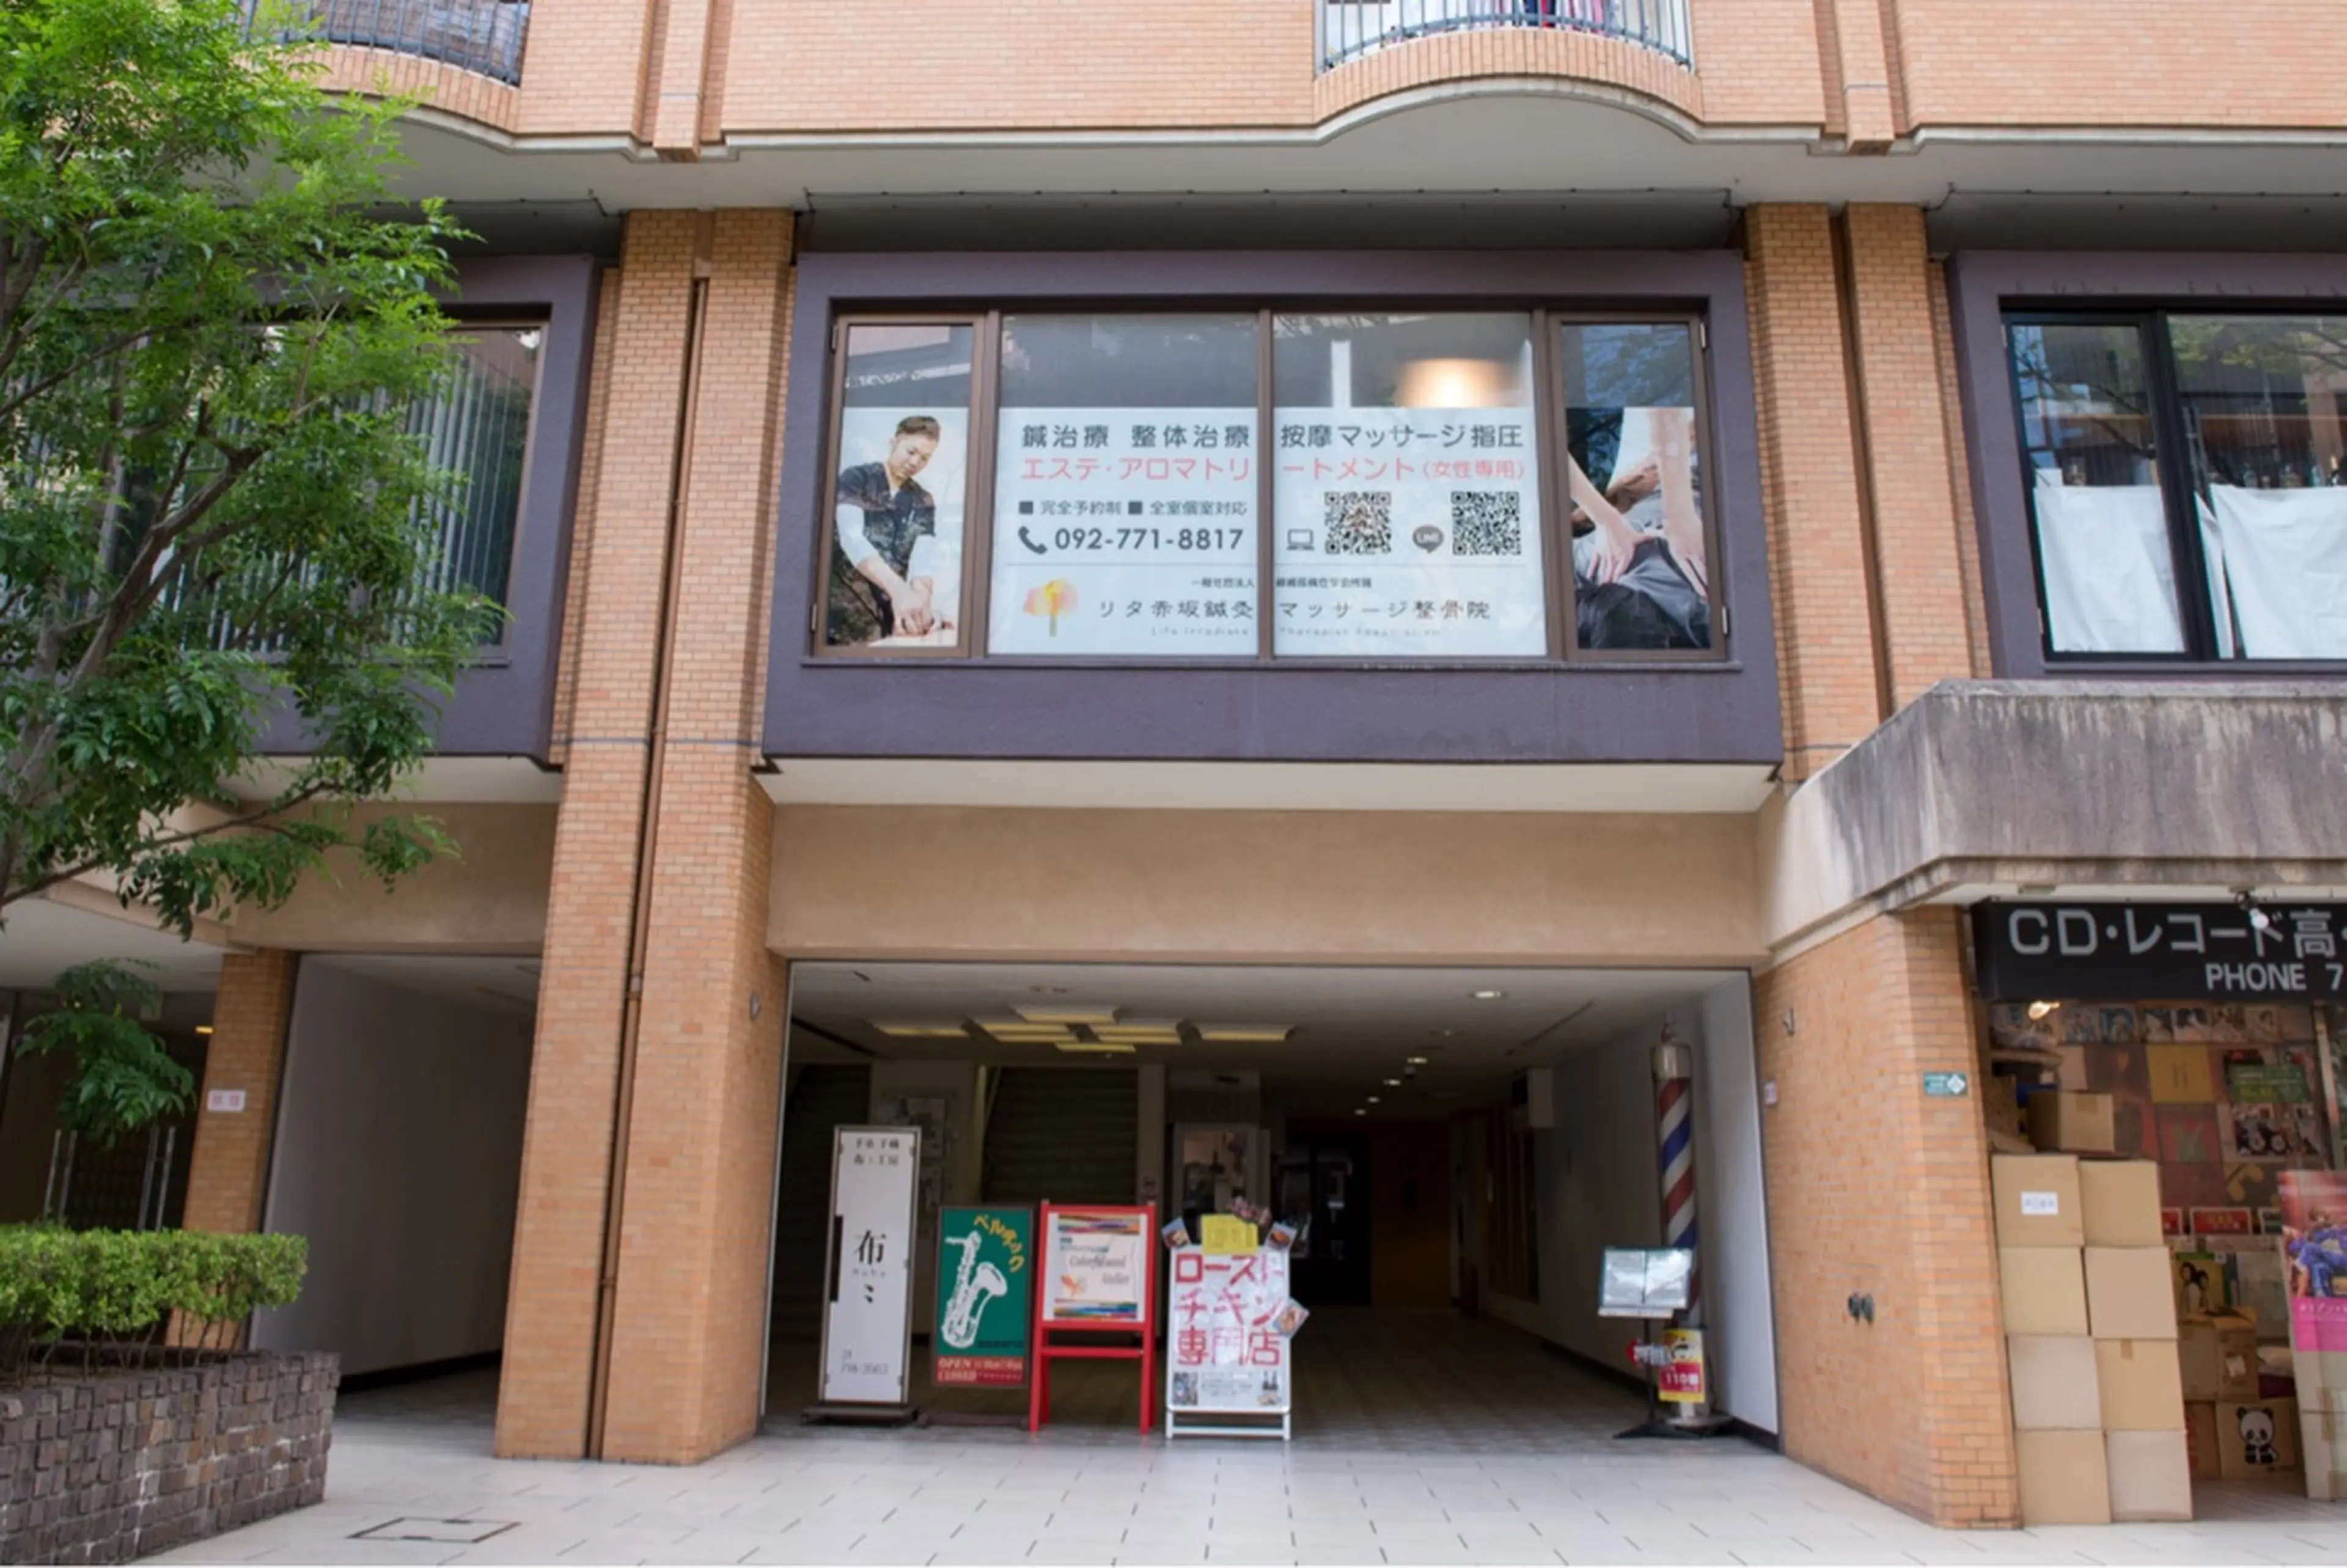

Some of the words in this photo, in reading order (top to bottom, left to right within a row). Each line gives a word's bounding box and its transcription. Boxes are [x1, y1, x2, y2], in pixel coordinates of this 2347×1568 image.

[1021, 424, 1109, 449] 鍼治療
[1131, 424, 1250, 449] 整体治療
[1280, 423, 1524, 449] 按摩マッサージ指圧
[1040, 500, 1122, 516] 完全予約制
[1054, 527, 1244, 551] 092-771-8817
[1279, 599, 1491, 620] マッサージ整骨院
[2205, 962, 2307, 991] PHONE
[1174, 1287, 1284, 1325] チキン
